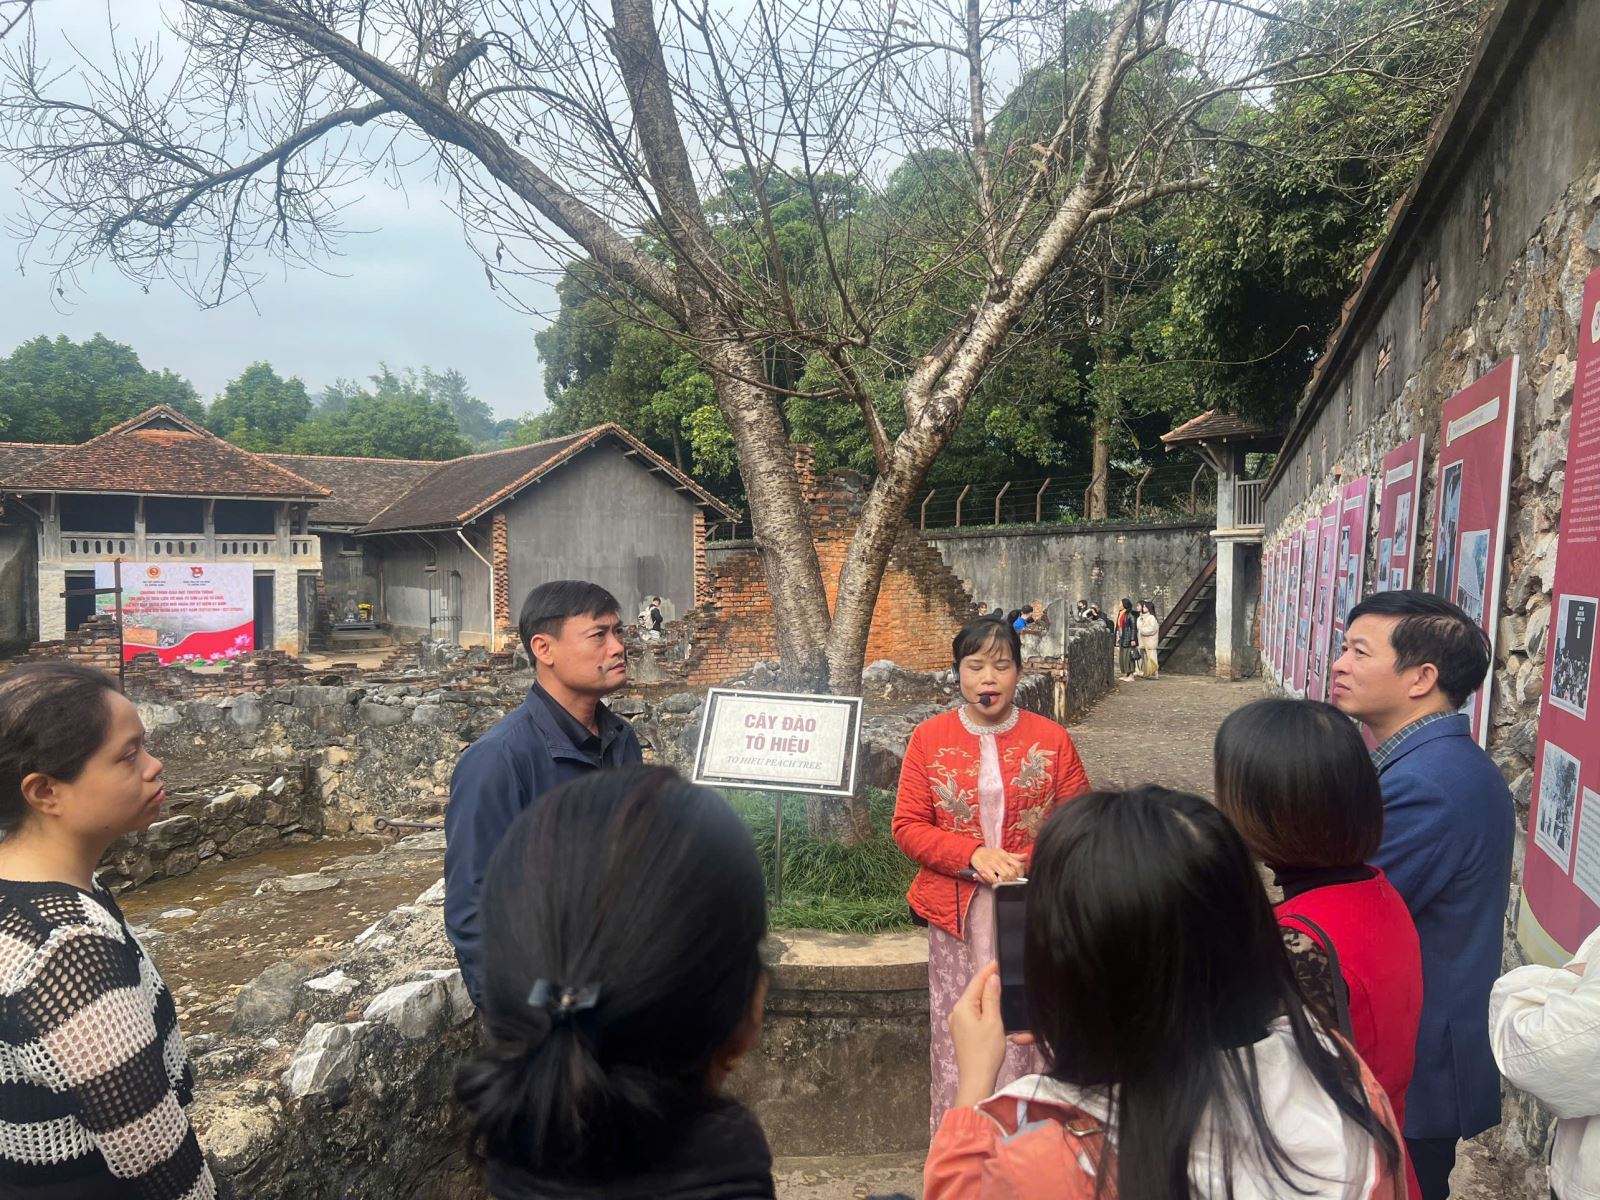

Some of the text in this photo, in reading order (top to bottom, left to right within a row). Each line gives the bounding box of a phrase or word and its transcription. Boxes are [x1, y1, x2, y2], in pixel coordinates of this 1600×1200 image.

[744, 712, 817, 732] CÂY ĐÀO
[746, 733, 810, 756] TÔ HIỆU
[765, 758, 797, 768] PEACH
[797, 760, 823, 770] TREE
